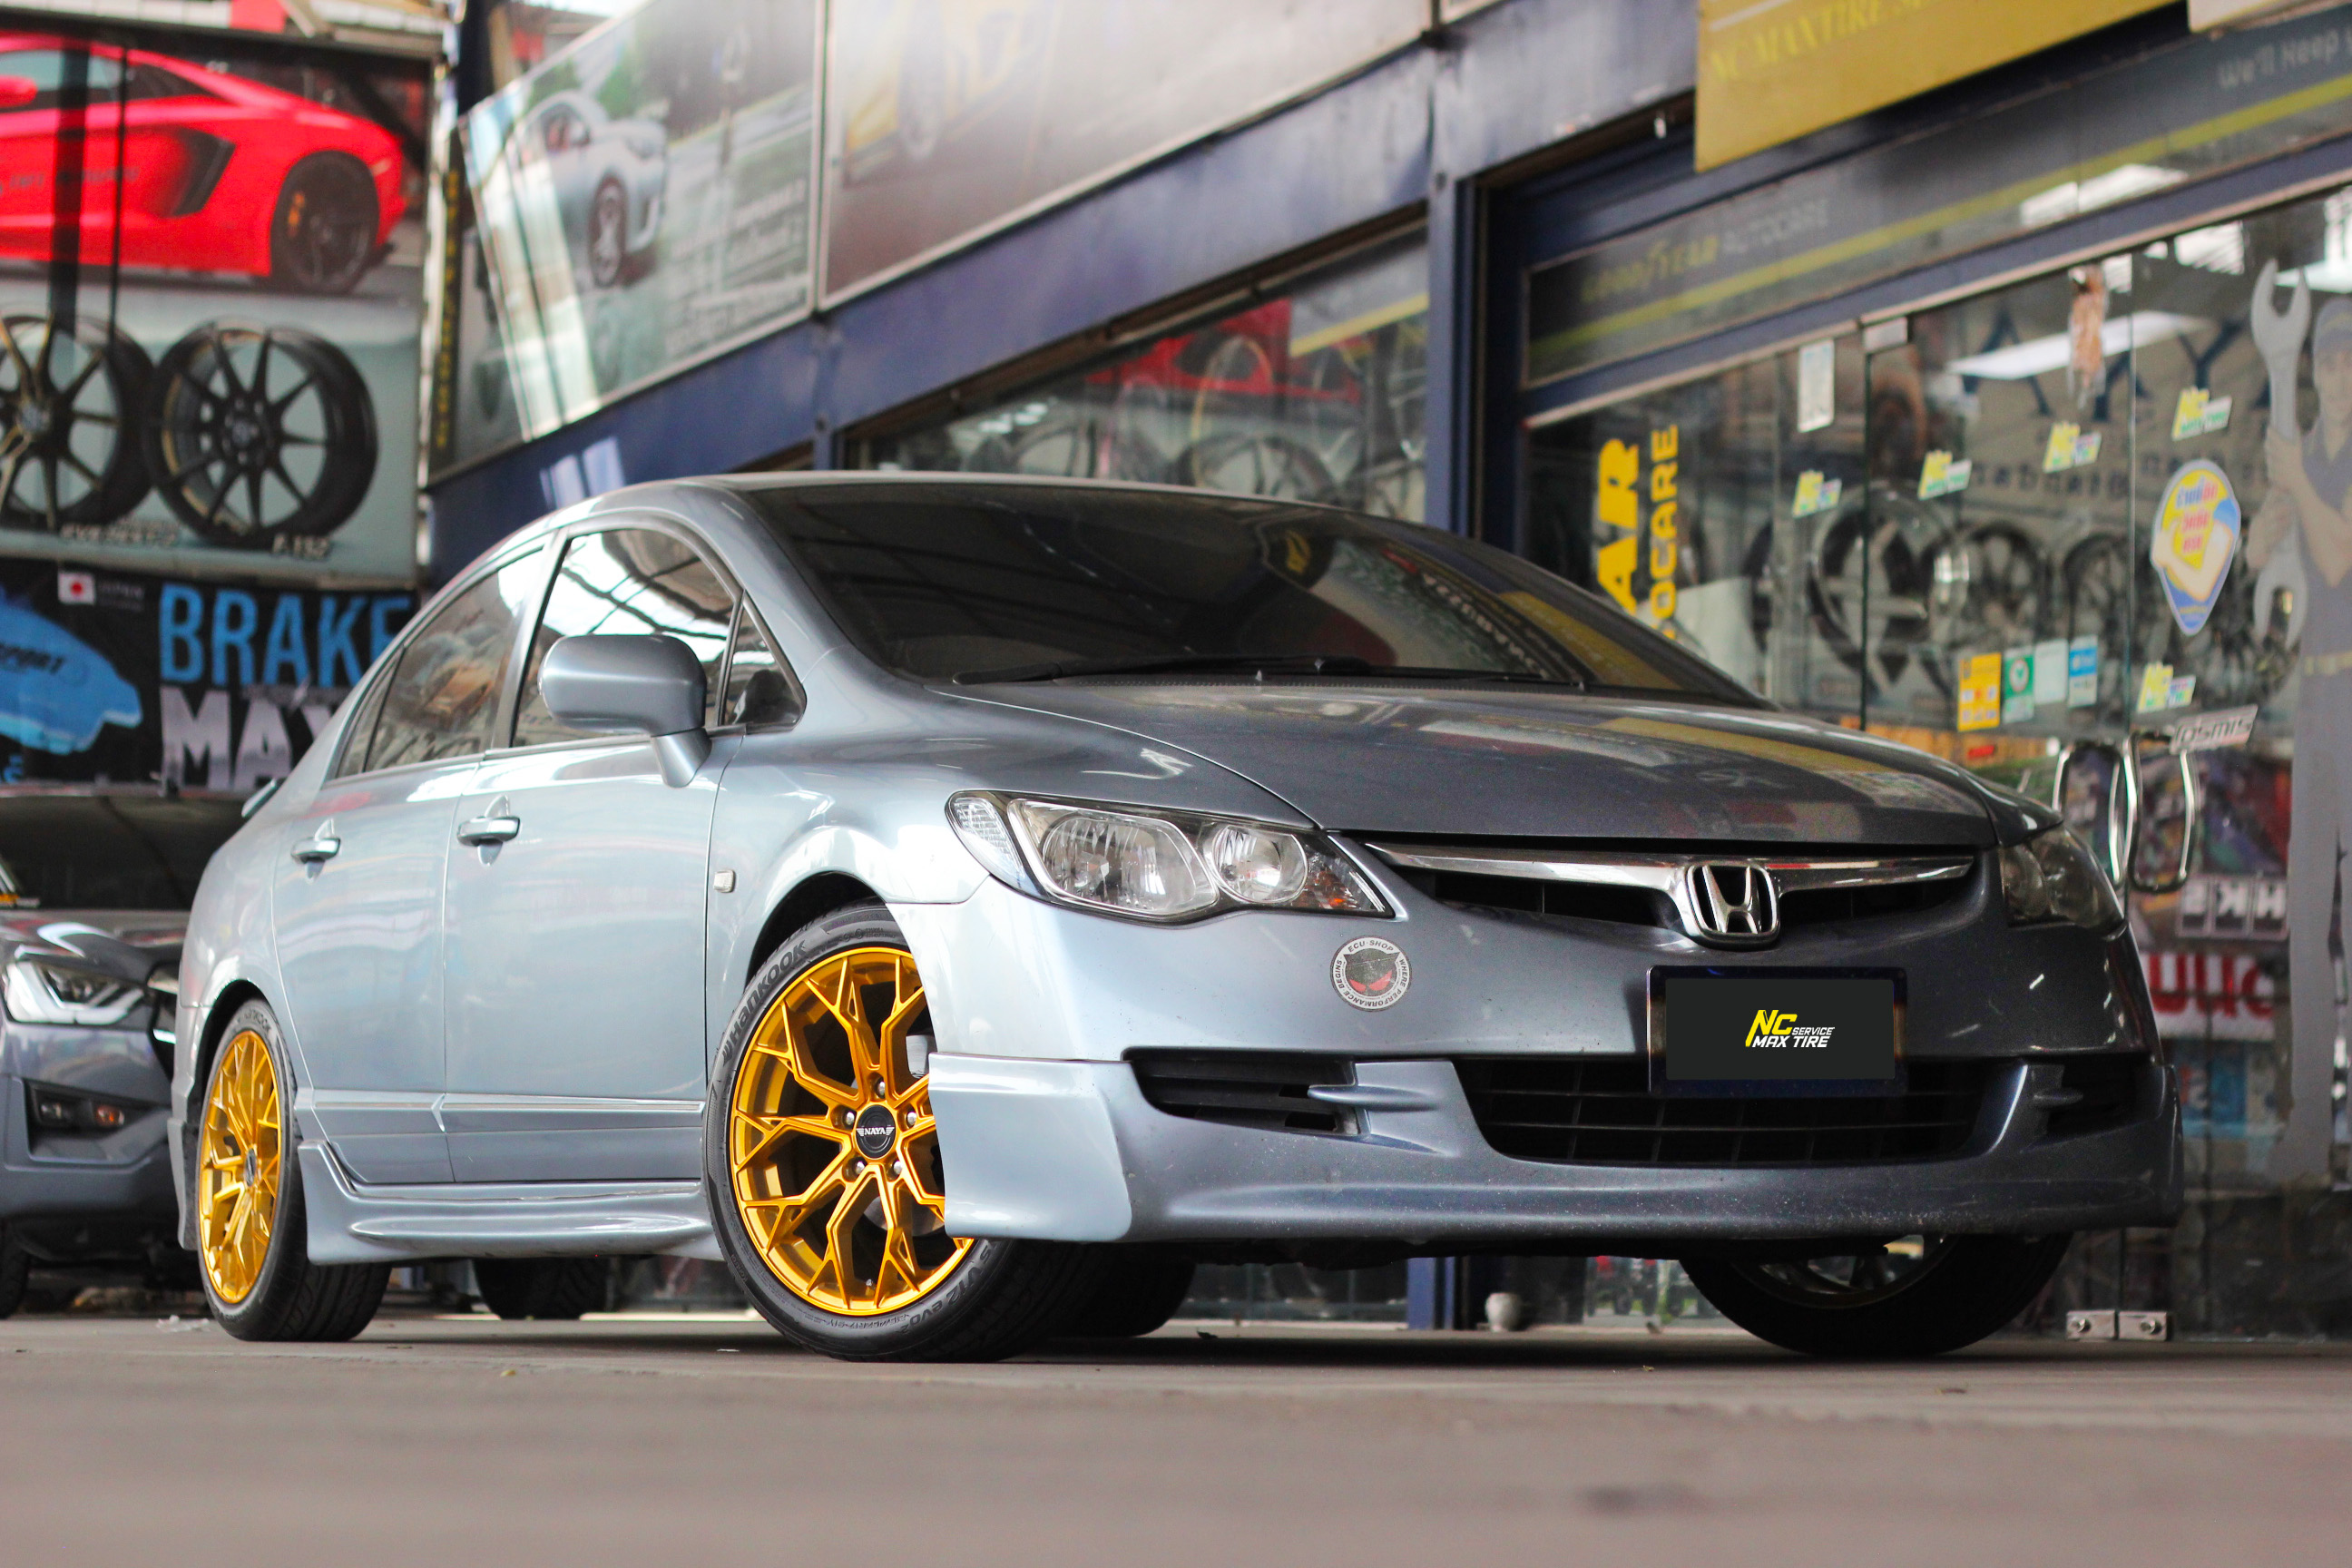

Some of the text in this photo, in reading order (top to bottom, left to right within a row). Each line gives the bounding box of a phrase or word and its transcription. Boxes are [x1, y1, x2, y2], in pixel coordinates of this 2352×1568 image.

[158, 583, 410, 687] BRAKE
[1348, 940, 1394, 953] ECU SHOP
[1334, 959, 1344, 989] BEGINS
[1398, 958, 1408, 987] WHERE
[864, 1127, 887, 1136] NAYA
